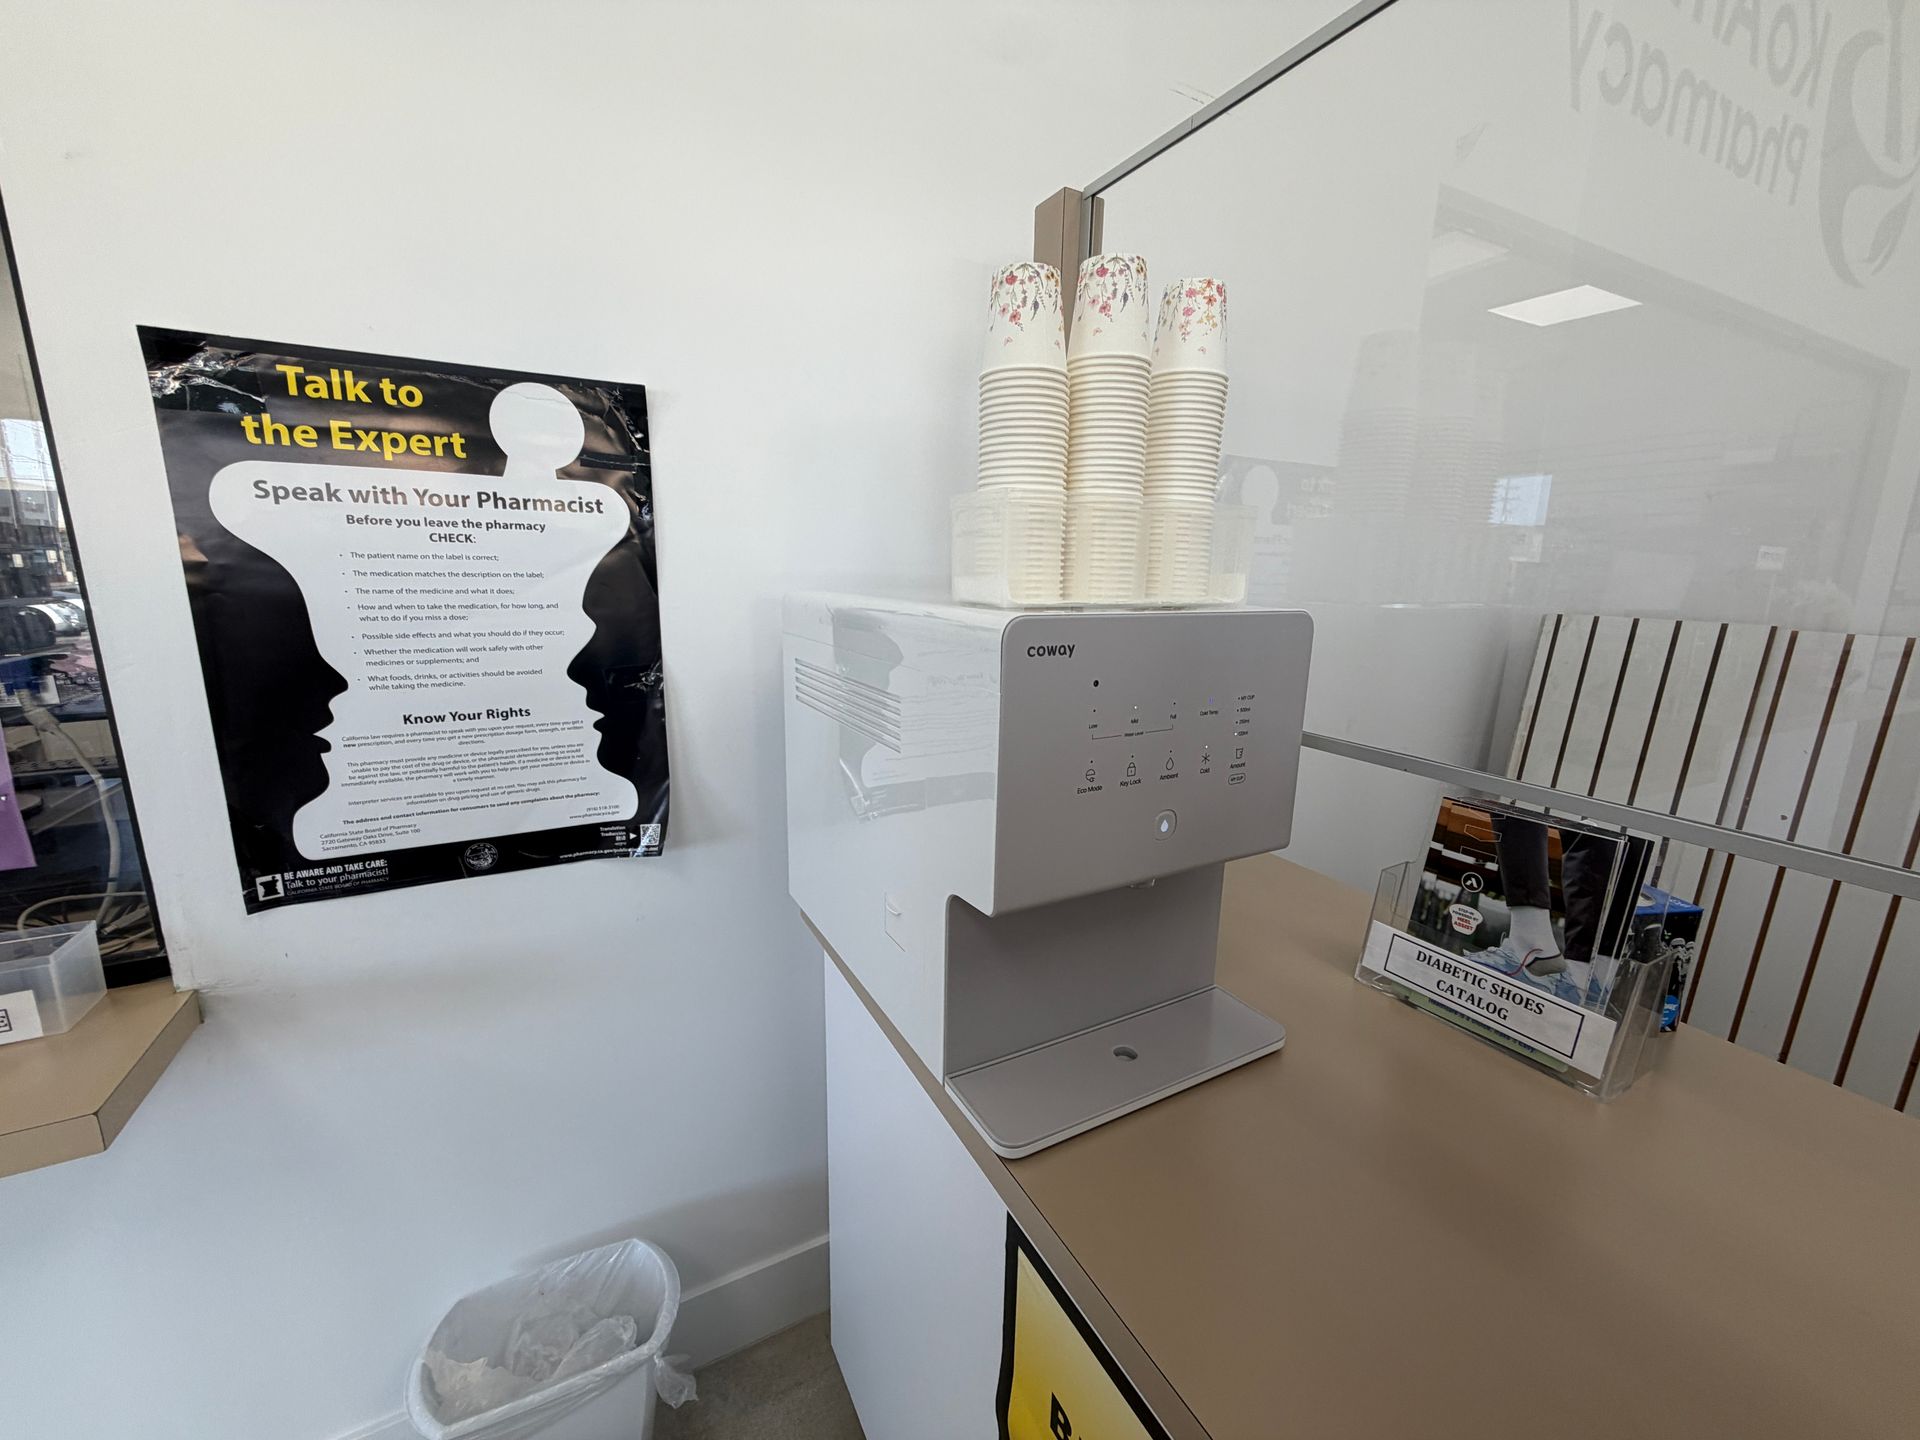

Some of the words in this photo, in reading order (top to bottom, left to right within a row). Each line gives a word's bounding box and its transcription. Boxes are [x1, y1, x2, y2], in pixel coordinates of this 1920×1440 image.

[276, 365, 373, 404] Talk
[379, 376, 423, 408] to
[241, 414, 318, 449] the
[331, 419, 467, 461] Expert
[252, 479, 342, 506] Speak
[349, 484, 407, 506] with
[412, 487, 471, 509] Your
[477, 491, 604, 515] Pharmacist
[346, 514, 392, 525] Before
[395, 518, 420, 528] you
[424, 517, 458, 528] leave
[461, 518, 482, 528] the
[485, 519, 545, 533] pharmacy
[429, 532, 476, 543] CHECK:
[350, 551, 365, 559] The
[361, 632, 393, 640] Possible
[1027, 642, 1076, 658] coway
[415, 657, 464, 665] supplements;
[402, 714, 446, 725] Know
[449, 711, 482, 722] Your
[486, 707, 531, 721] Rights
[1119, 779, 1129, 788] Key
[1129, 777, 1142, 786] Lock
[1159, 772, 1179, 781] Ambient
[1077, 787, 1087, 796] Eco
[1088, 784, 1103, 793] Mode
[337, 836, 361, 844] Gateway
[283, 871, 294, 880] BE
[296, 867, 324, 878] AWARE
[326, 865, 343, 874] AND
[344, 862, 364, 871] TAKE
[365, 859, 387, 868] CARE:
[285, 878, 304, 890] Talk
[306, 878, 316, 886] to
[317, 876, 337, 887] your
[339, 867, 389, 883] pharmacist!
[1416, 950, 1487, 990] DIABETIC
[1490, 983, 1545, 1015] SHOES
[1436, 979, 1509, 1021] CATALOG
